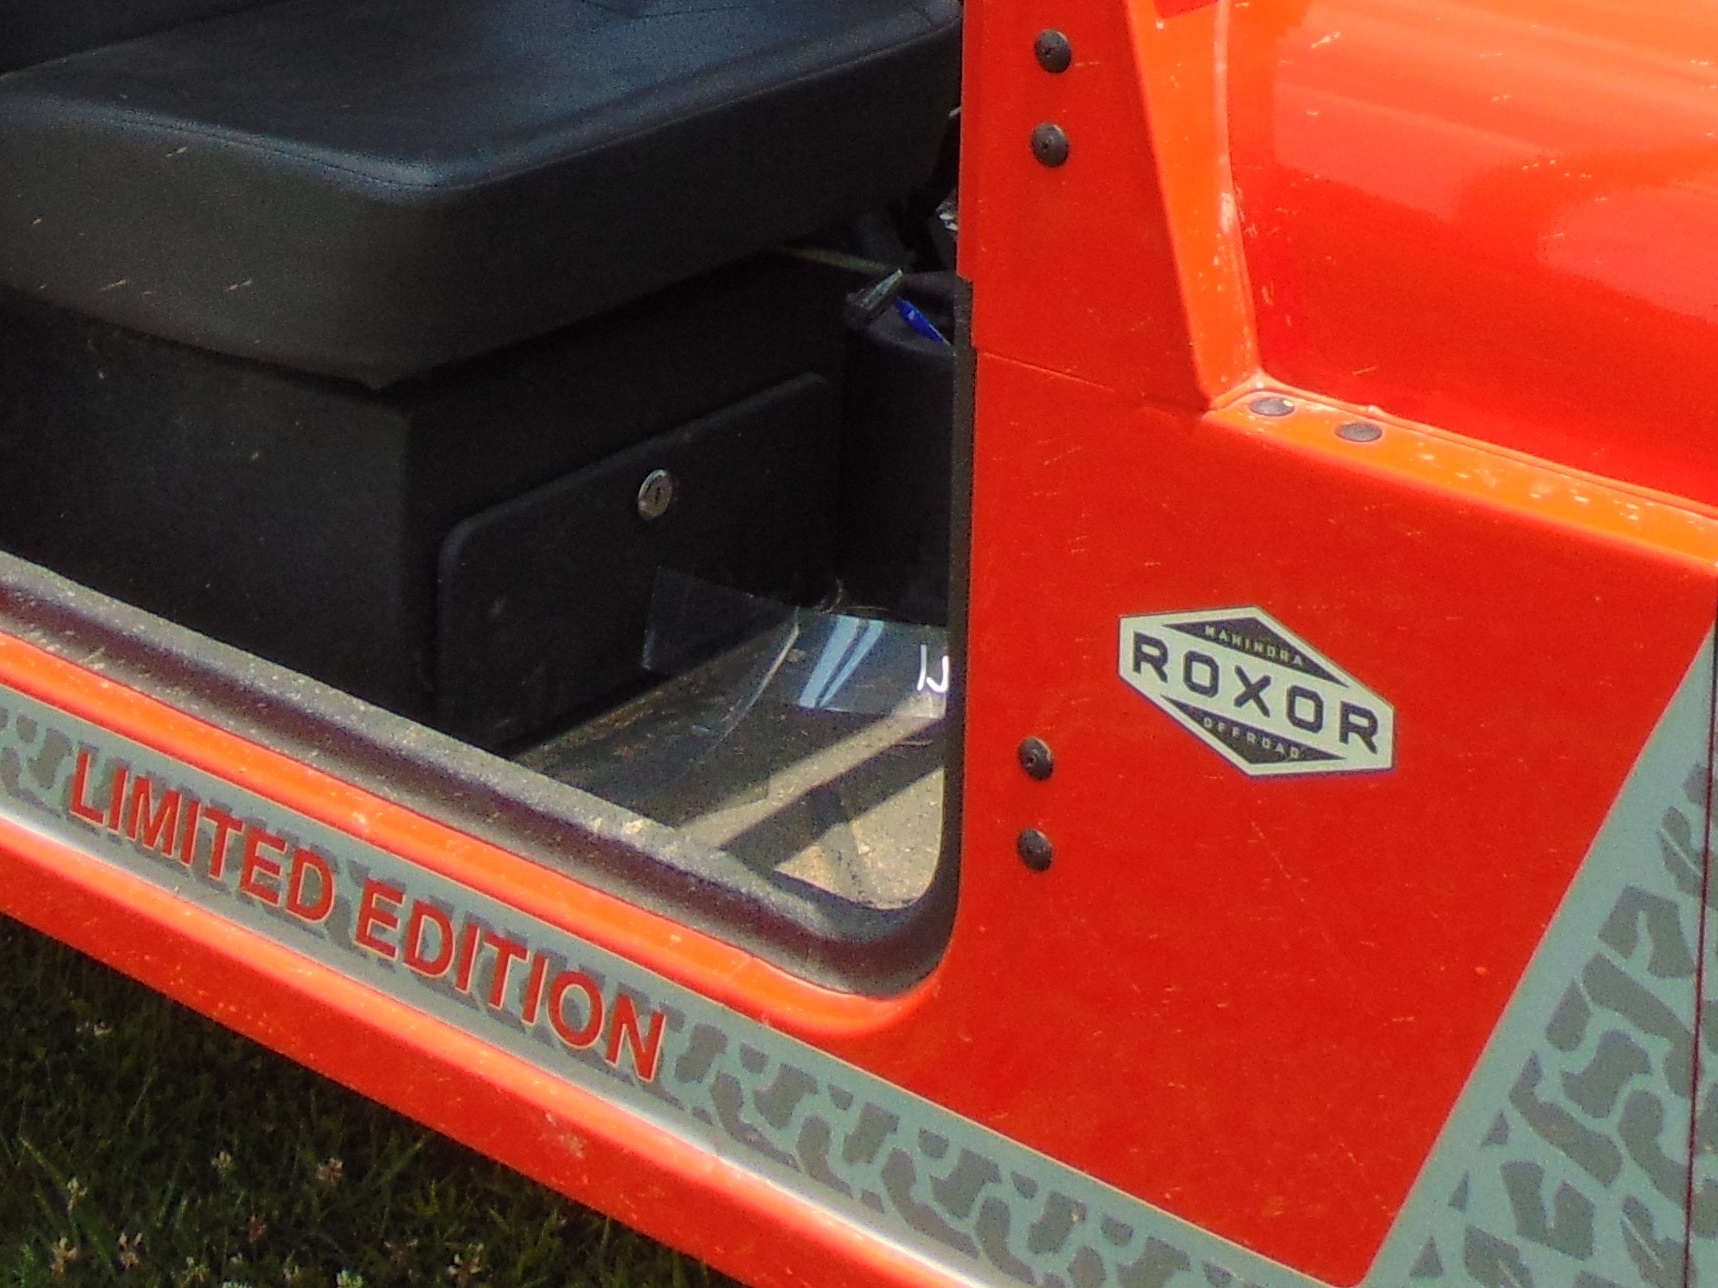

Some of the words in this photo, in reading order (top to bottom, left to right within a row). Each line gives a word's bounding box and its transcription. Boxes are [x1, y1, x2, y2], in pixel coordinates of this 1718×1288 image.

[1132, 630, 1379, 755] ROXOR
[1204, 624, 1304, 667] MAHINDRA
[68, 747, 336, 924] LIMITED
[353, 876, 669, 1084] EDITION
